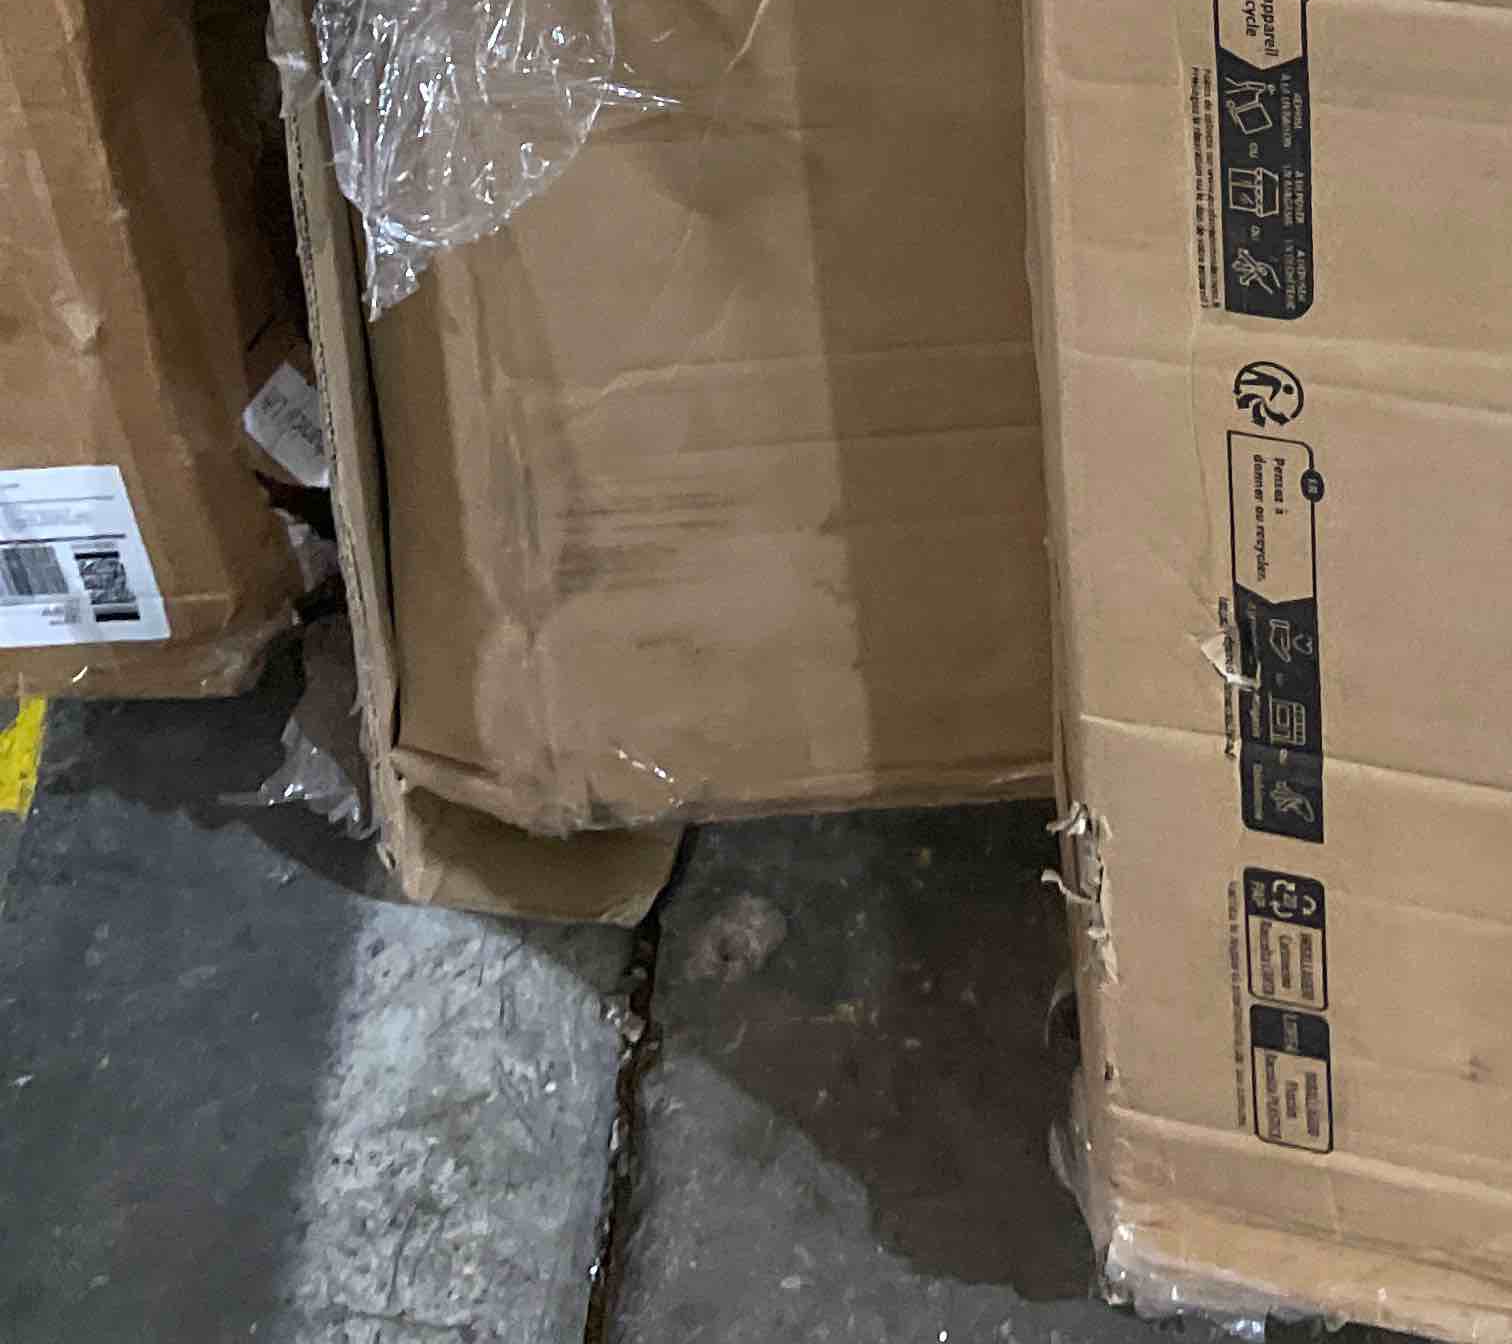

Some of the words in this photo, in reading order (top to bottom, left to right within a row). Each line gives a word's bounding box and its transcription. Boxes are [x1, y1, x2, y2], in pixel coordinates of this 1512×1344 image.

[1251, 454, 1268, 501] donner
[1271, 457, 1287, 503] Pensez
[1253, 505, 1265, 523] ou
